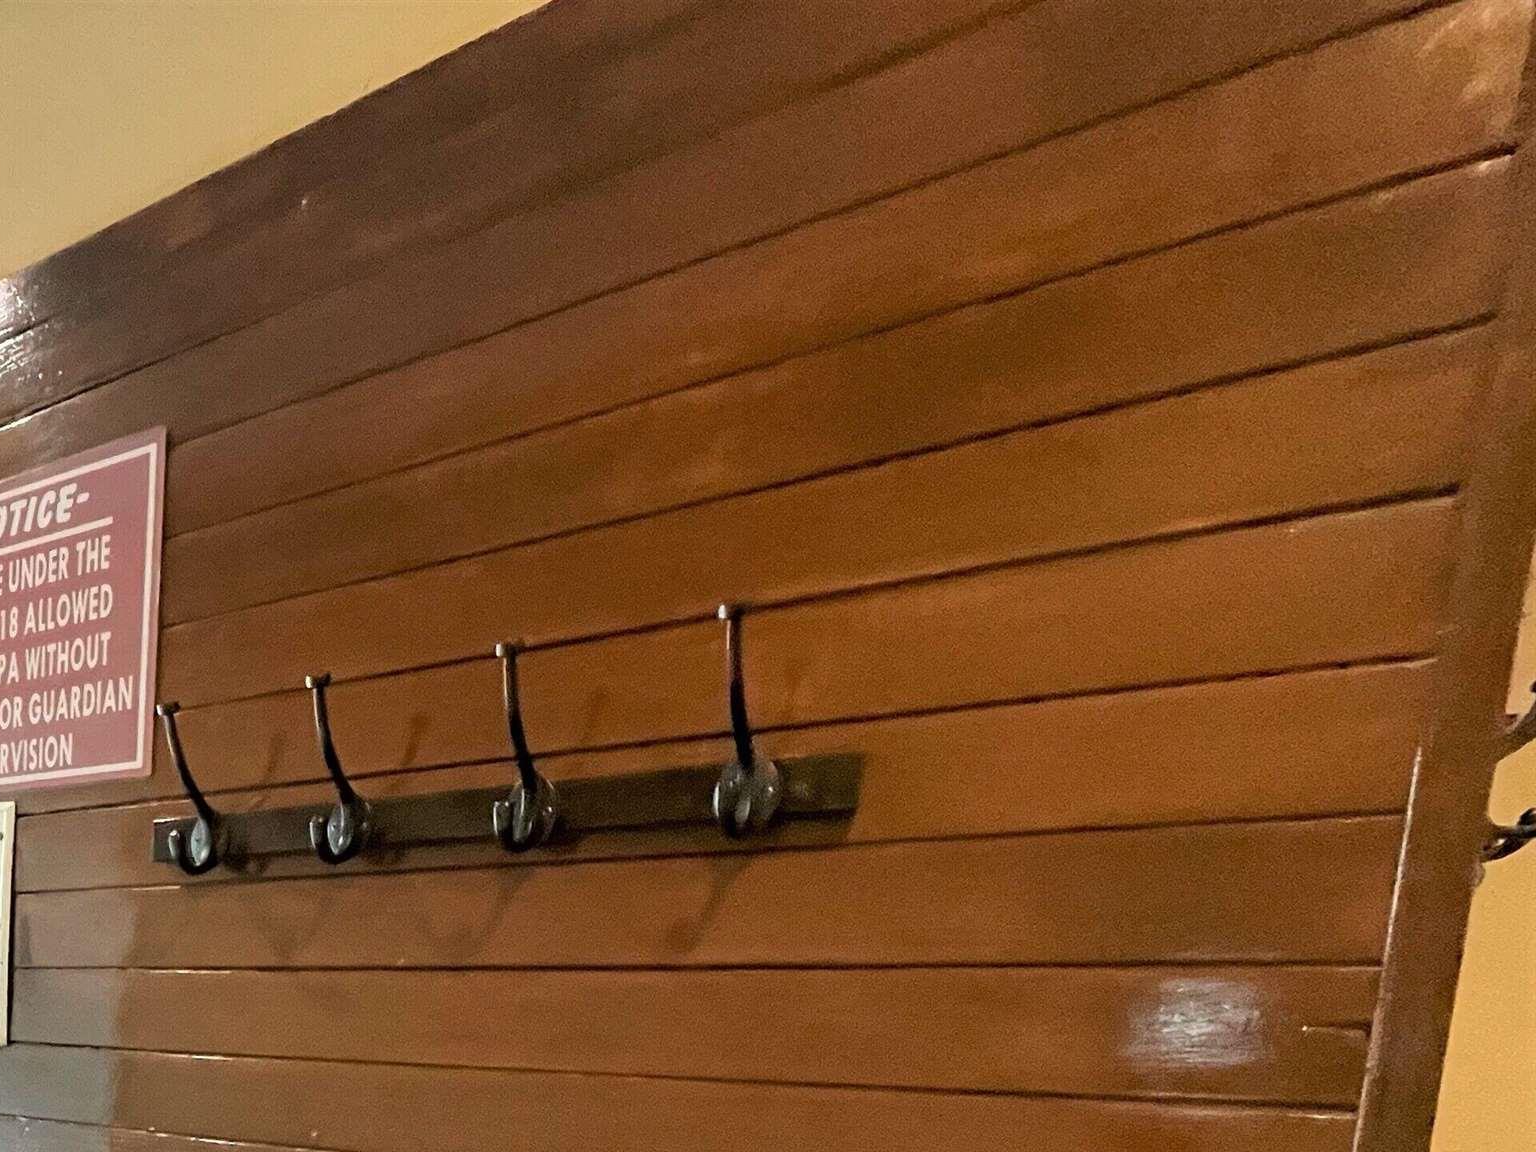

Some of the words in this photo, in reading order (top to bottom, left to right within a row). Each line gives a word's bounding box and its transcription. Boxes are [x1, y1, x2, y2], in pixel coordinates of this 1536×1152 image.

[8, 550, 69, 594] UNDER
[76, 535, 111, 576] THE
[0, 609, 18, 640] 18
[23, 583, 113, 637] ALLOWED
[25, 632, 111, 682] WITHOUT
[0, 697, 23, 731] OR
[28, 676, 134, 724] GUARDIAN
